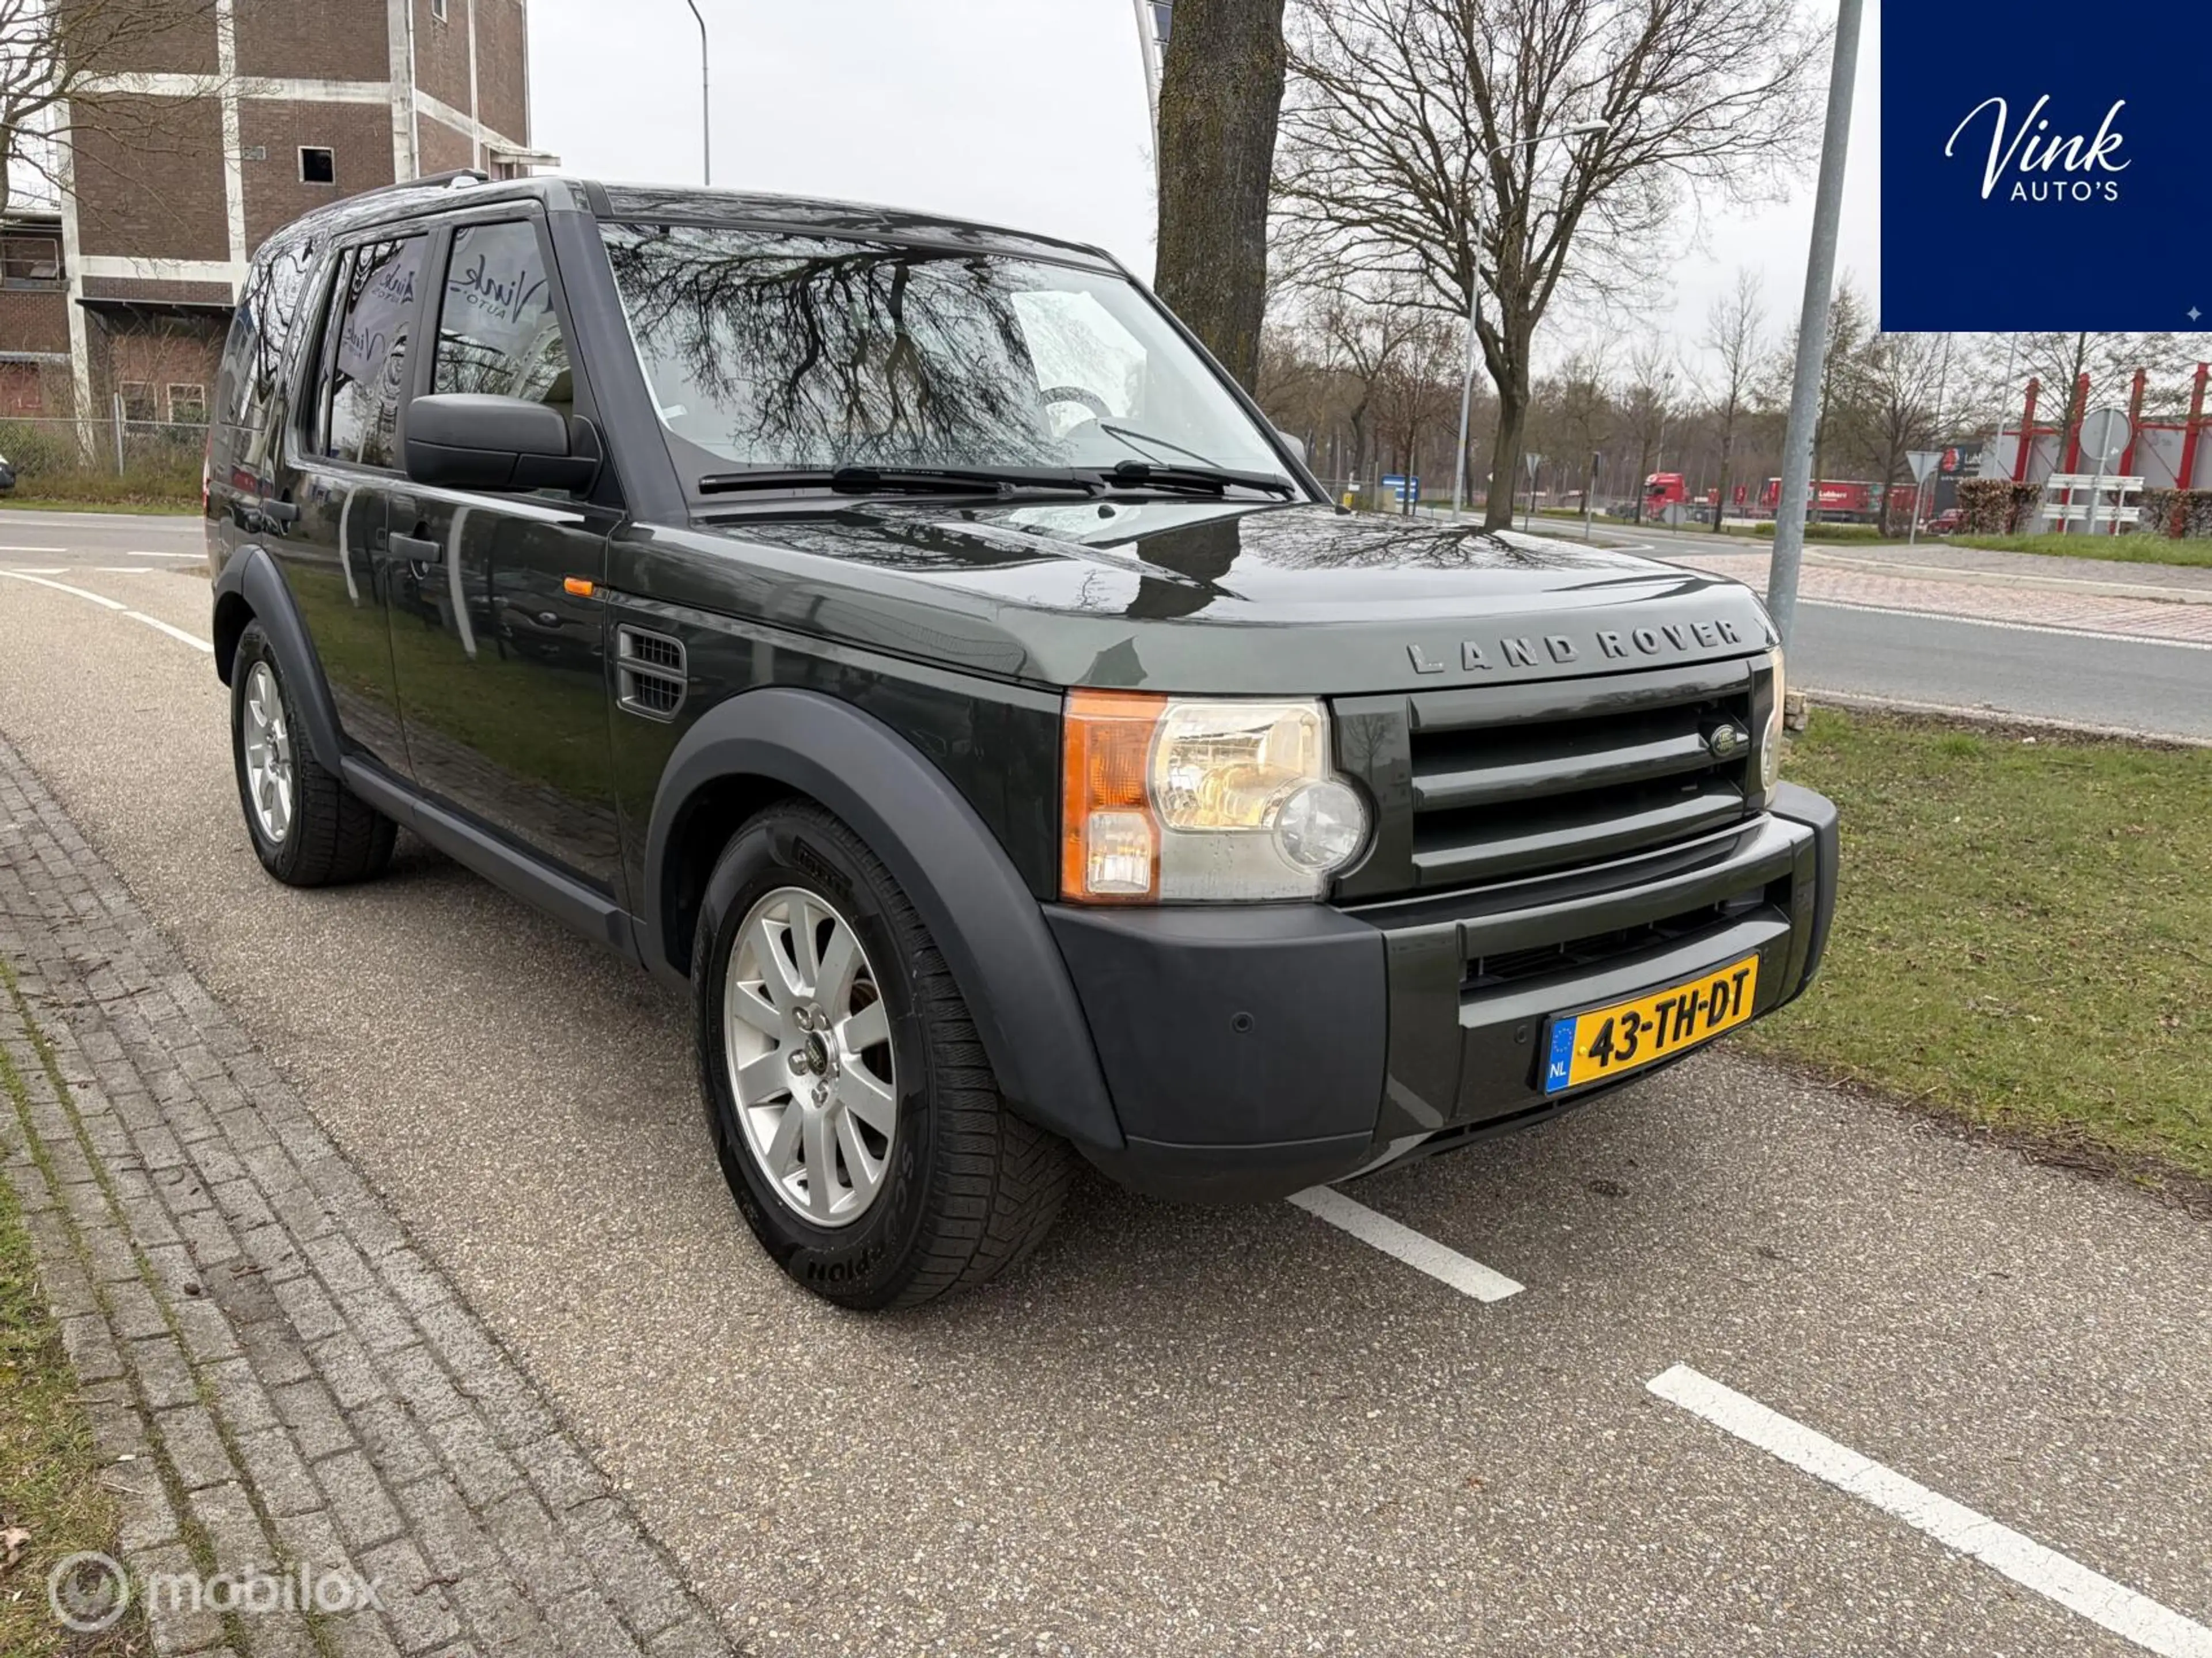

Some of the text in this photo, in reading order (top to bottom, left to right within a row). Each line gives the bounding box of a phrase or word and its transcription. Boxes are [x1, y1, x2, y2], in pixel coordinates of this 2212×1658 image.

[1407, 619, 1742, 674] LAND ROVER
[1588, 968, 1750, 1068] 43-TH-DT
[1550, 1063, 1566, 1079] NL
